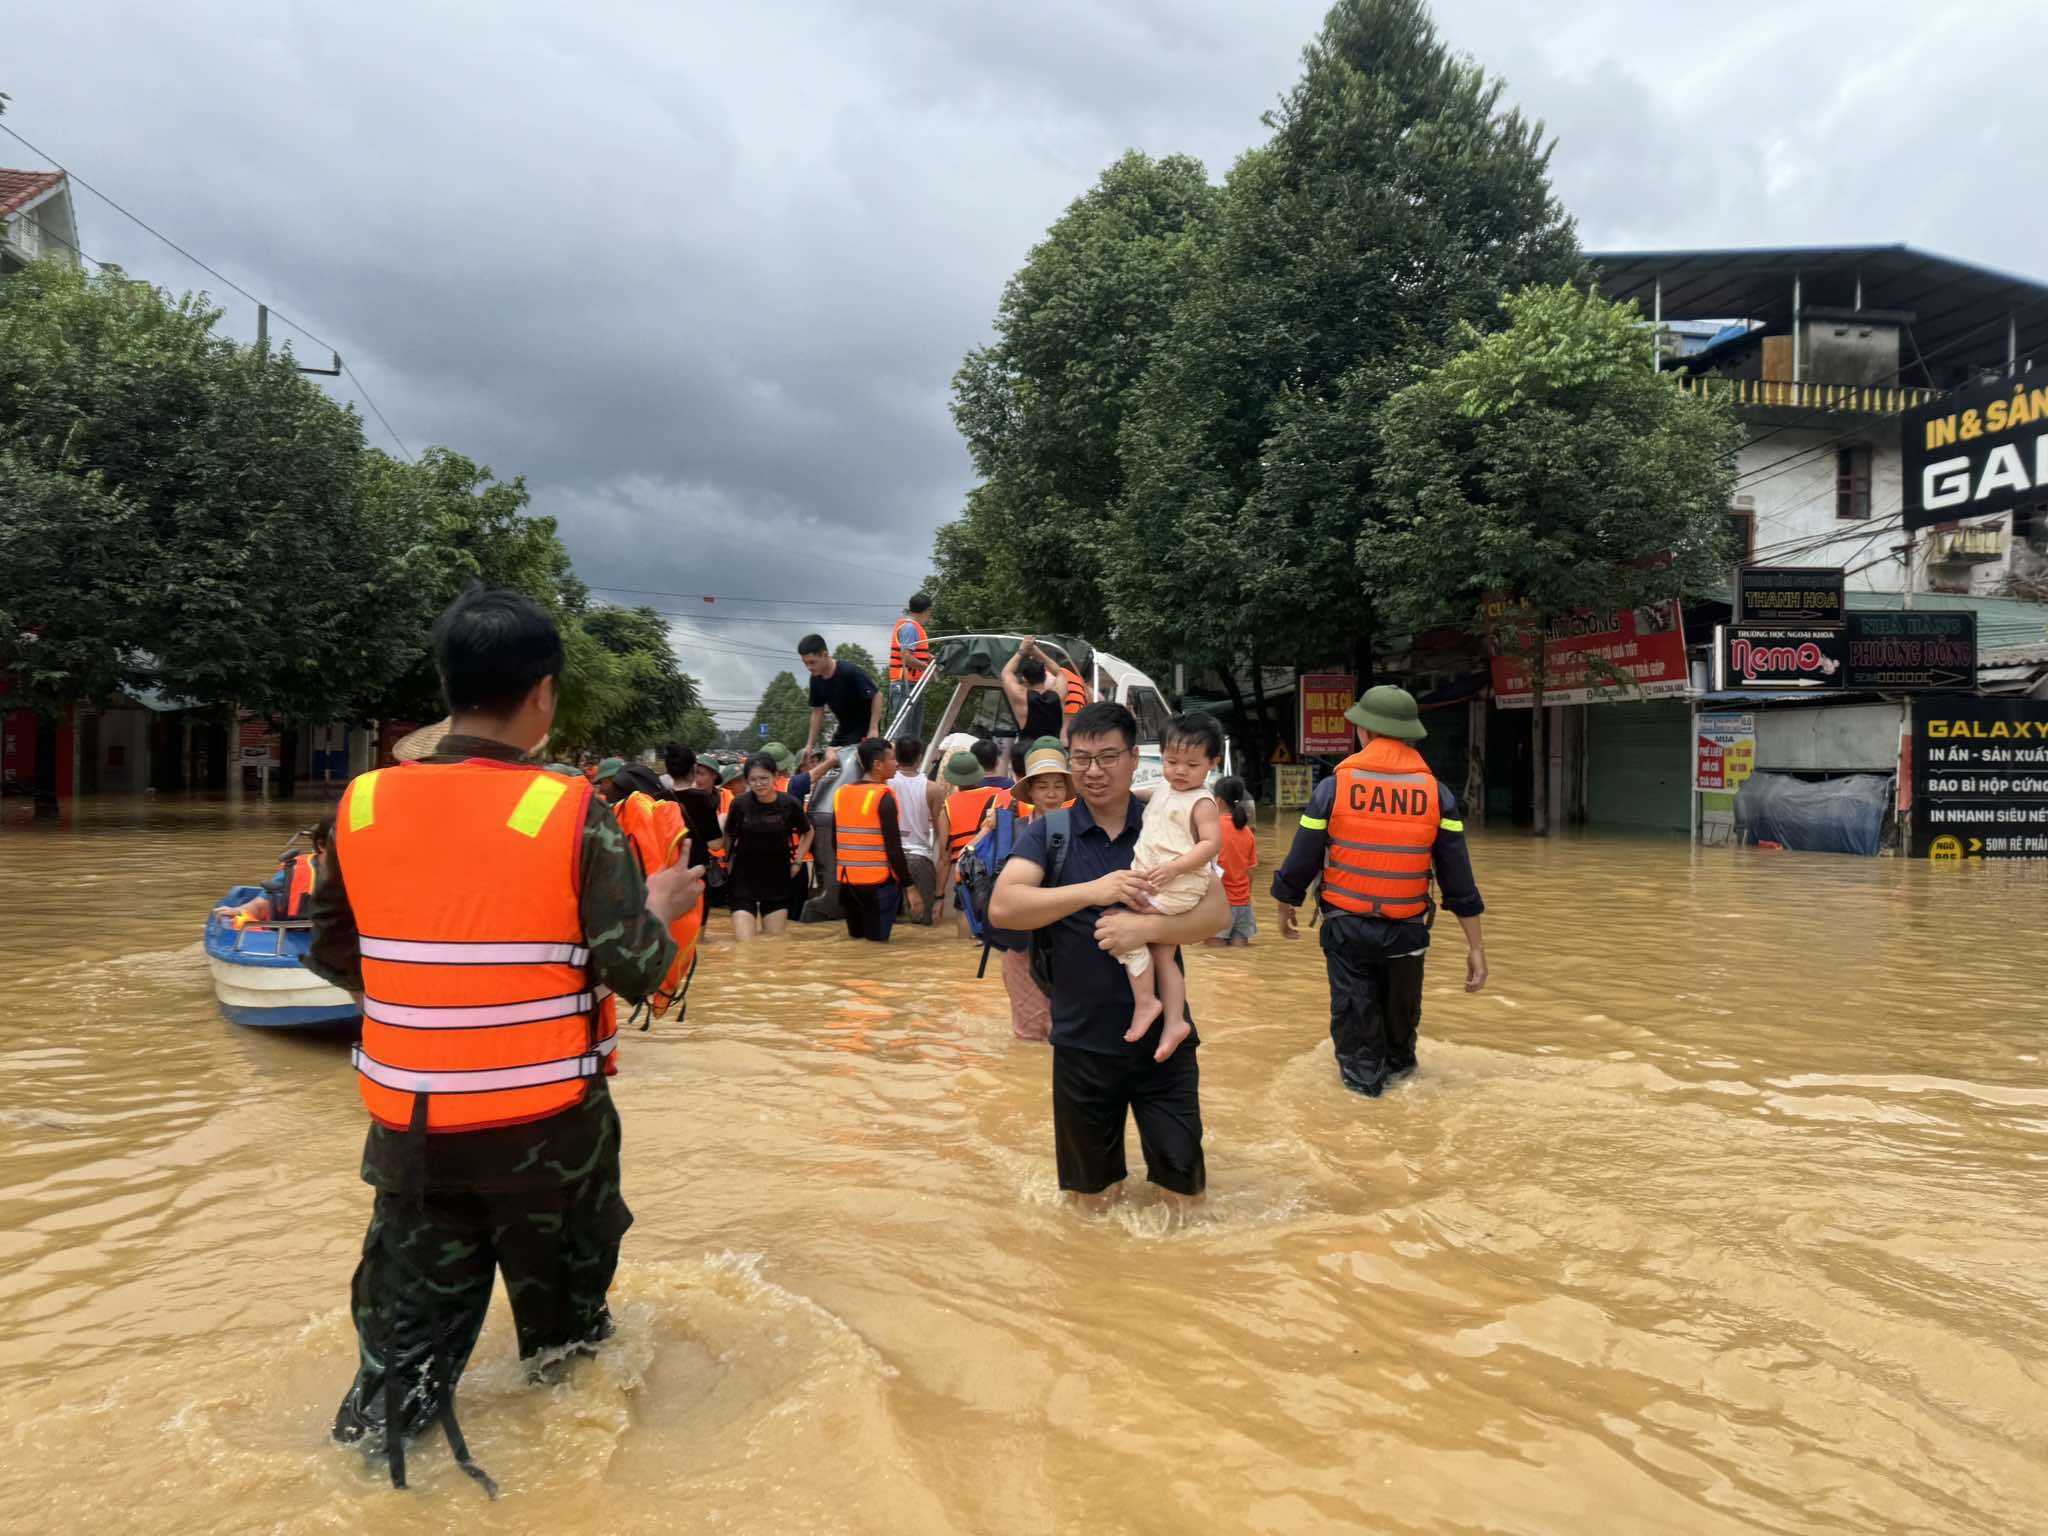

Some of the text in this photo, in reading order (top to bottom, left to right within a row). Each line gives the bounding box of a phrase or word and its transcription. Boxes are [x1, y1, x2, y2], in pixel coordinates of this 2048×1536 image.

[1926, 414, 1957, 451] IN
[1960, 409, 1984, 440] &
[1745, 591, 1801, 608] THANH
[1928, 720, 2048, 738] GALAXY
[1929, 748, 1944, 761] IN
[1948, 745, 1969, 761] ẤN
[1982, 746, 2011, 761] SẢN
[1929, 780, 1958, 792] BAO
[1962, 777, 1976, 792] BÌ
[1979, 777, 2008, 795] HỘP
[1350, 784, 1427, 816] CAND
[1931, 810, 1944, 822] IN
[1947, 810, 1994, 822] NHANH
[1996, 807, 2026, 822] SIÊU
